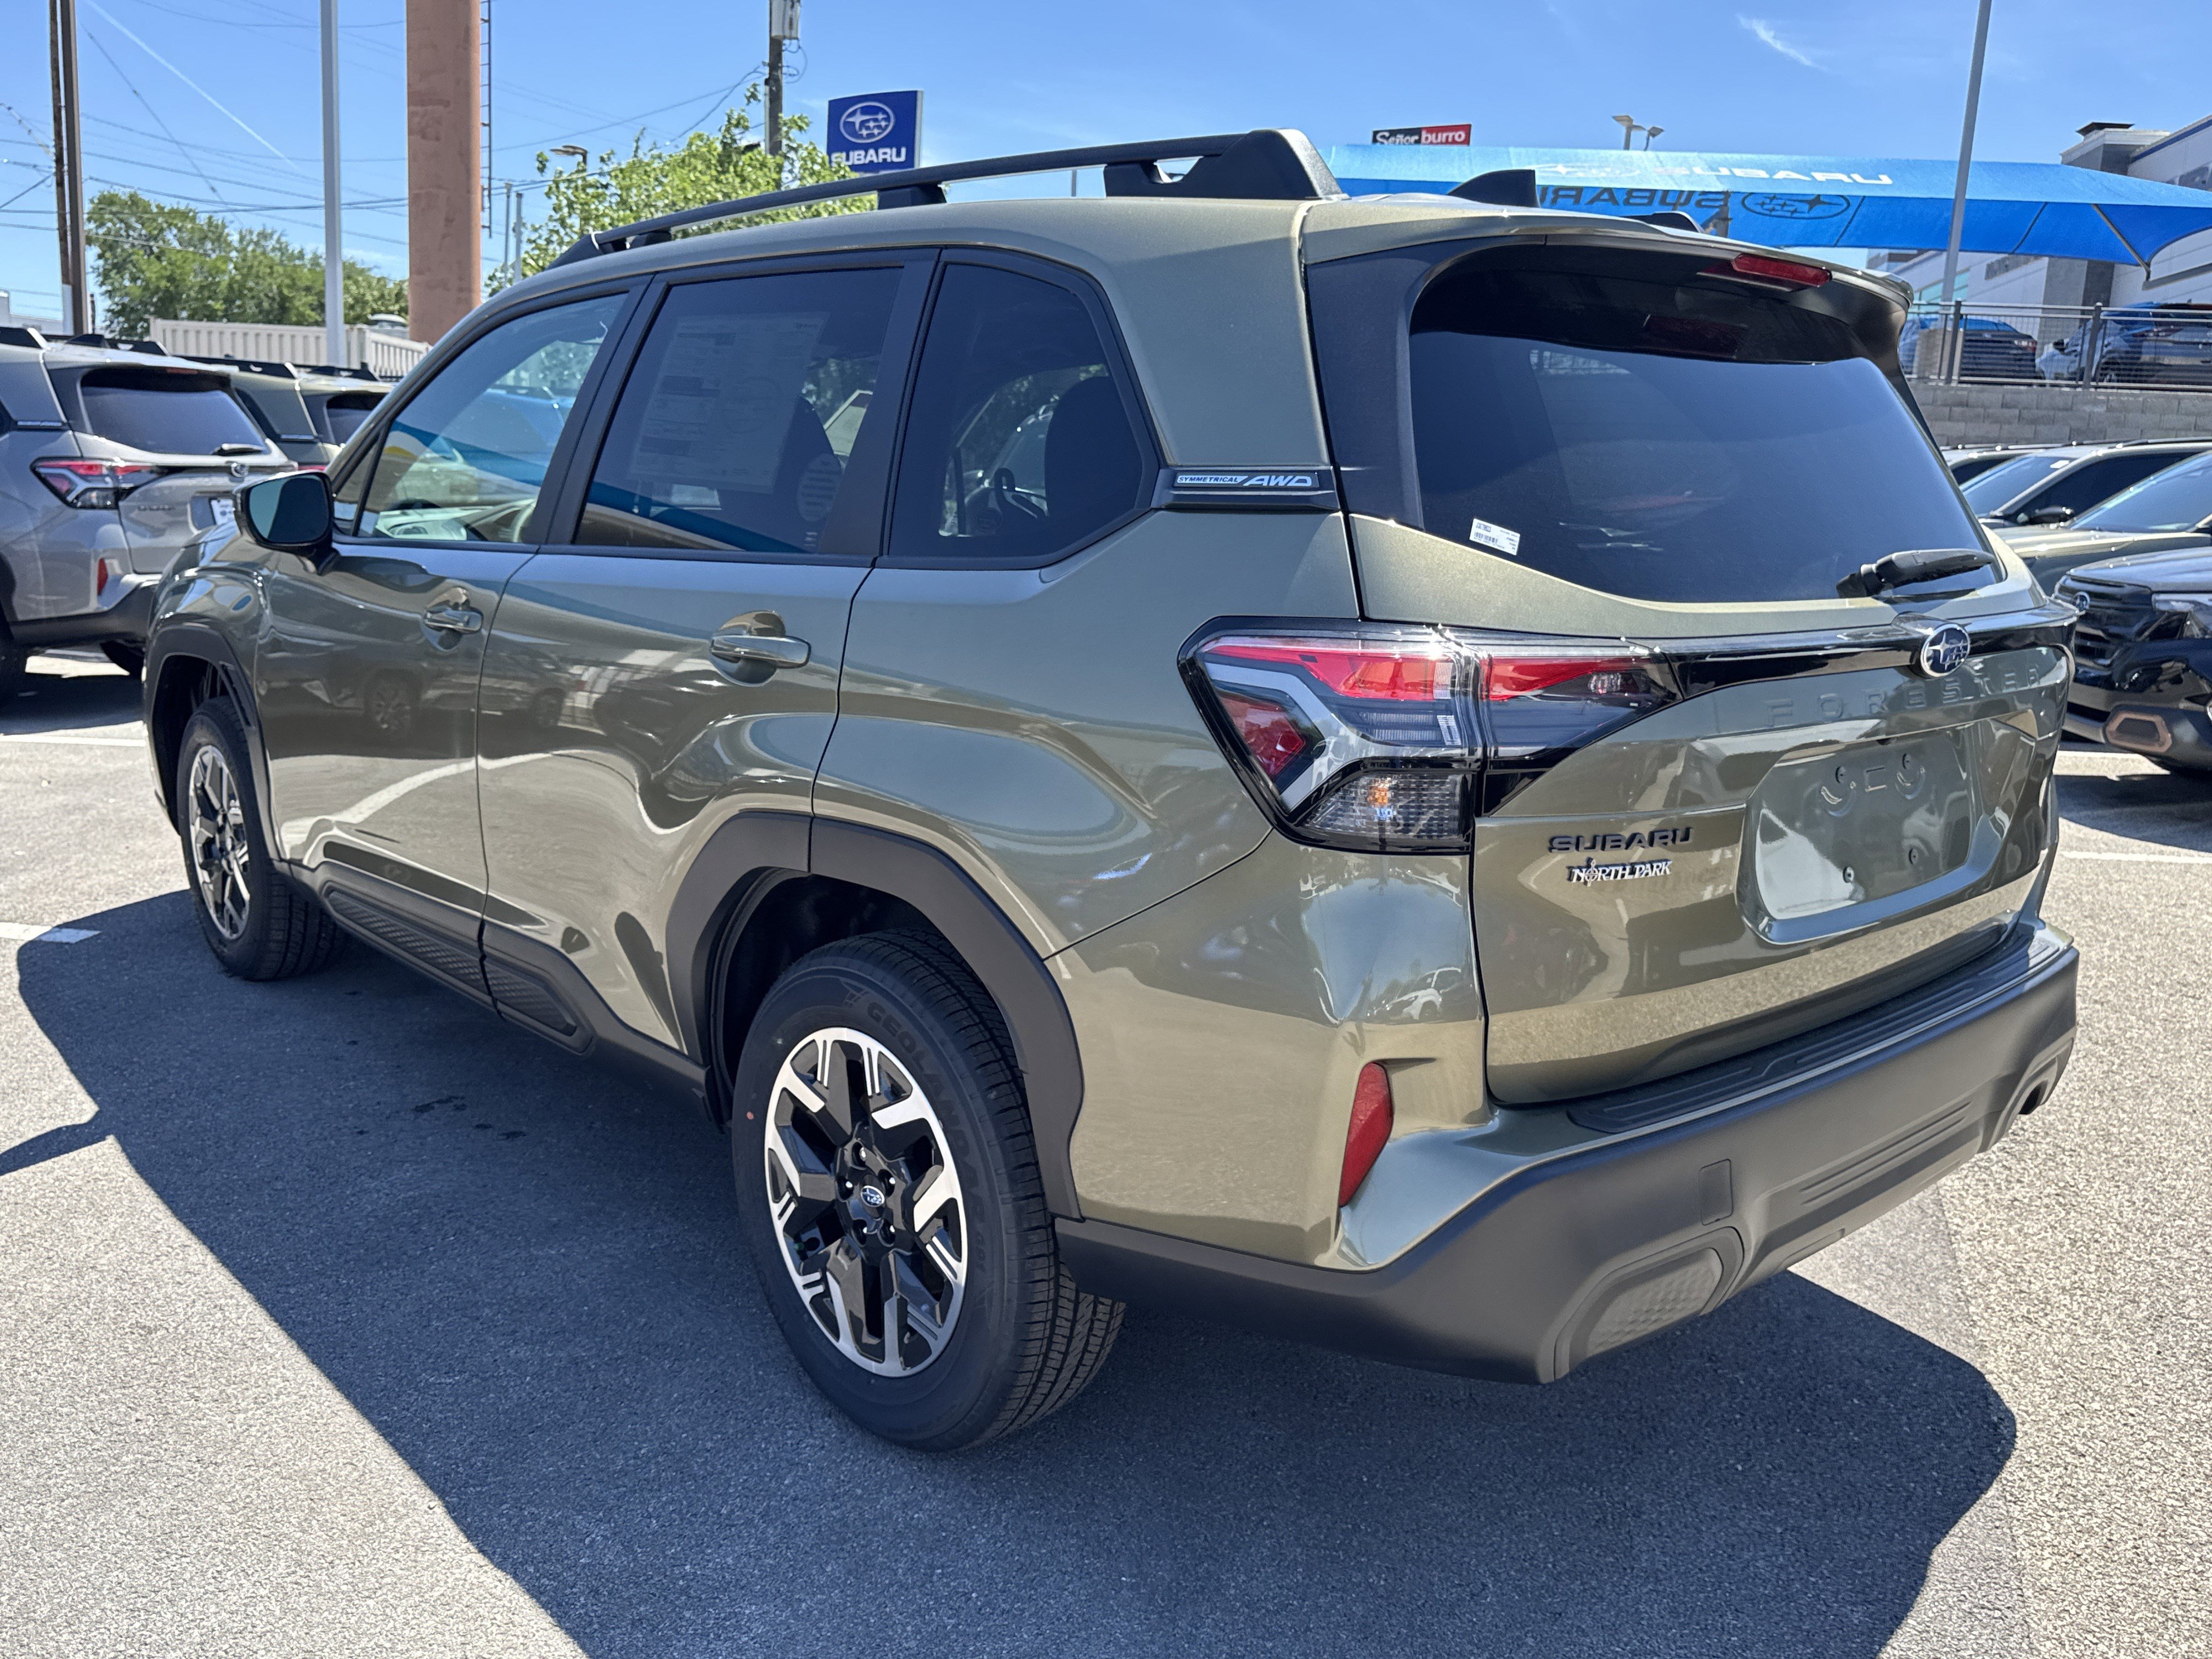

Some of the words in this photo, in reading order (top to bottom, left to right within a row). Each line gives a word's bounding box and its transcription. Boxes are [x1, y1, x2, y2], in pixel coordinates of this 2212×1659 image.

[1421, 129, 1466, 143] burro
[830, 146, 906, 167] SUBARU
[1652, 166, 1893, 184] SUBARU
[1243, 475, 1312, 486] AWD
[1764, 666, 2040, 727] FORESTER
[1548, 827, 1694, 853] SUBARU
[867, 1001, 986, 1224] GEOLANDAR
